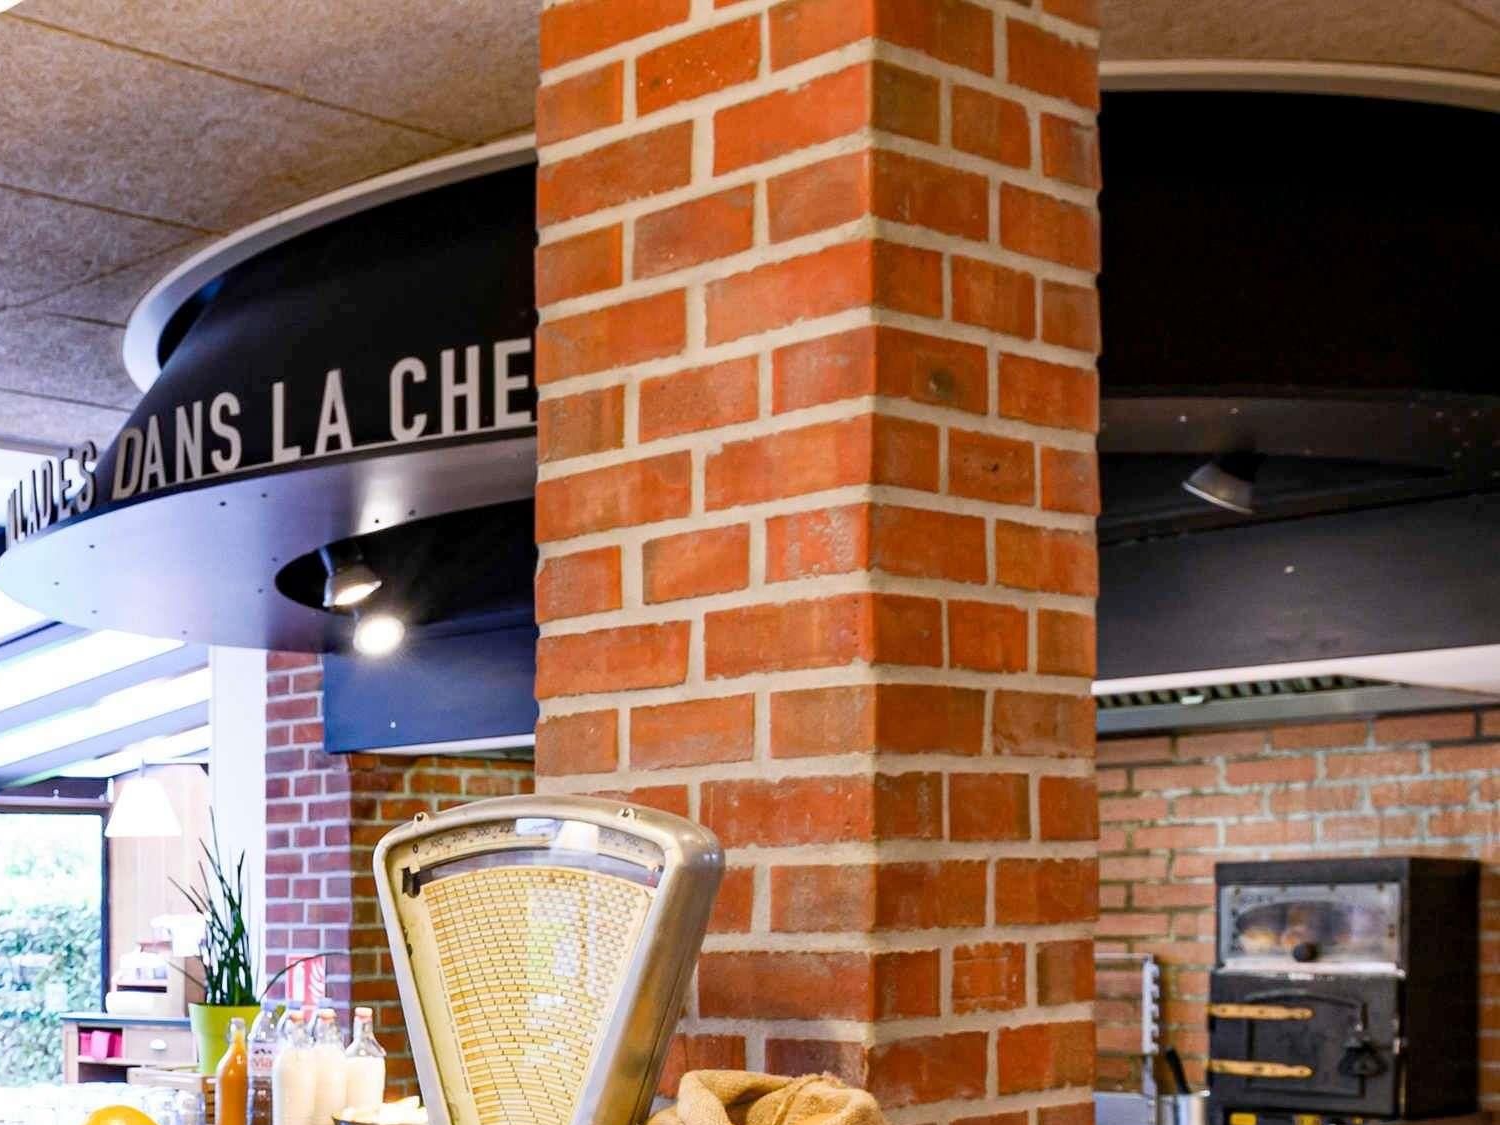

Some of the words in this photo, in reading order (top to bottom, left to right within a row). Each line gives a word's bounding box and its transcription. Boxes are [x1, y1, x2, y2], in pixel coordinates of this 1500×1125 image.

[112, 390, 243, 500] DANS
[272, 368, 354, 463] LA
[389, 338, 532, 444] CHE
